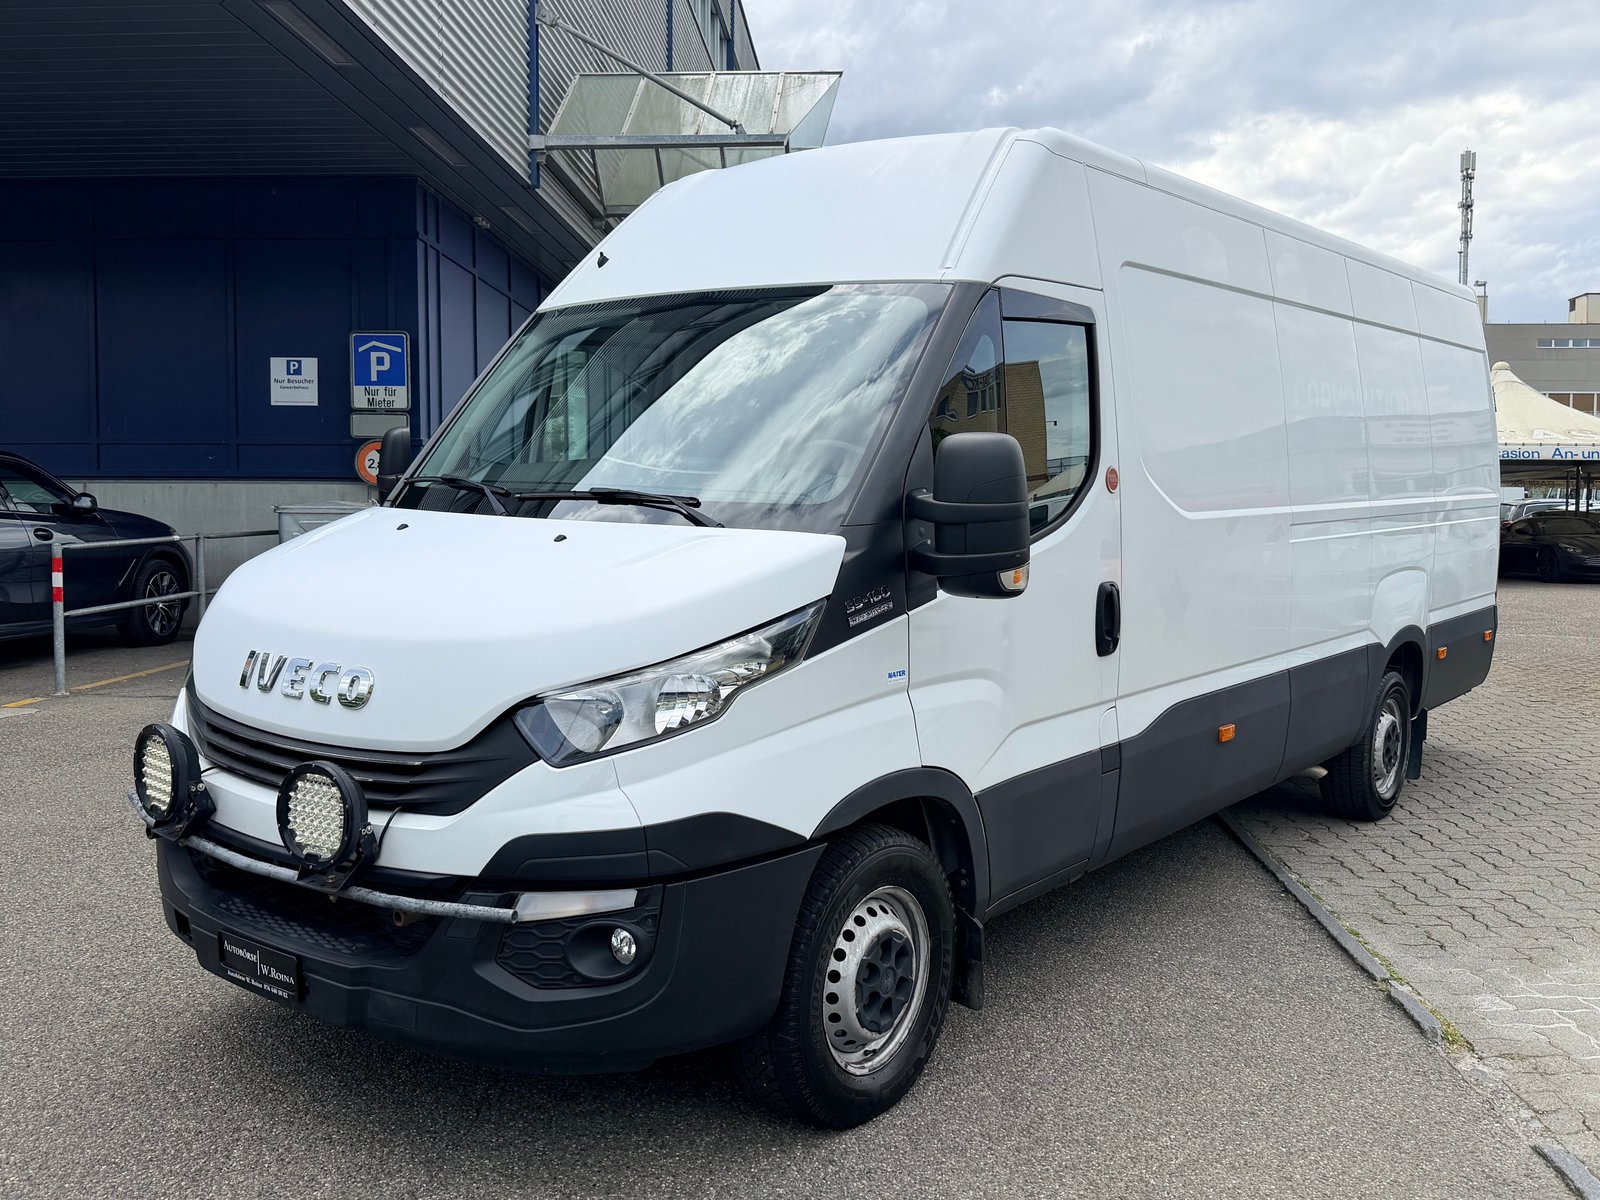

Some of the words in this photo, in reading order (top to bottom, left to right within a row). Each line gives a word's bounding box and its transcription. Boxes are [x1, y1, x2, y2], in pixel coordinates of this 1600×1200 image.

[289, 361, 299, 374] P
[370, 351, 391, 382] P
[364, 387, 380, 397] Nur
[384, 387, 397, 397] für
[367, 397, 395, 408] Mieter
[1499, 447, 1540, 459] asion
[239, 649, 376, 711] IVECO
[887, 670, 906, 678] NATER
